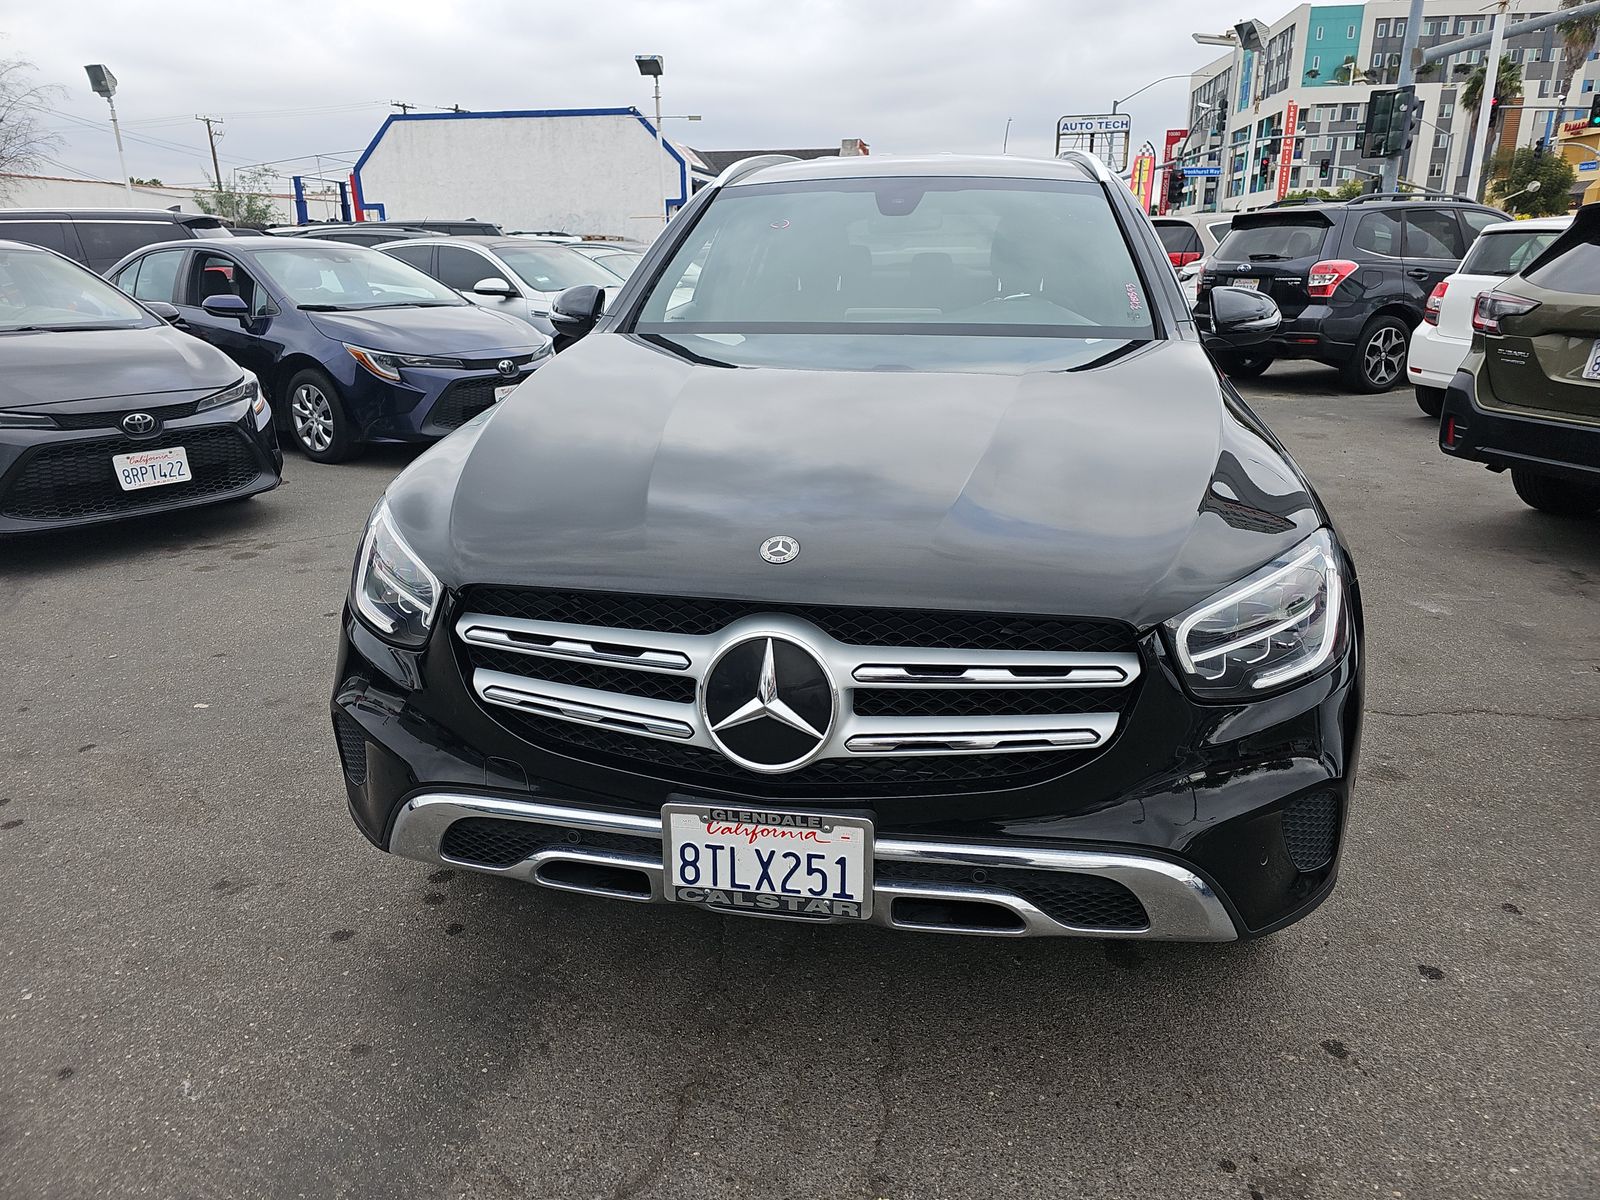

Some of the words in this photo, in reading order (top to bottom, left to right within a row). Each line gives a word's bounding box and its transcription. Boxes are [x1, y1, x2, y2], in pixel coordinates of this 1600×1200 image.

[1061, 121, 1094, 131] AUTO
[1097, 120, 1129, 130] TECH
[1210, 167, 1220, 175] Way
[128, 454, 174, 465] California
[122, 460, 186, 485] 8RPT422
[712, 809, 821, 828] GLENDALE
[706, 821, 831, 845] California
[679, 842, 854, 900] 8TLX251
[677, 887, 861, 917] CALSTAR
